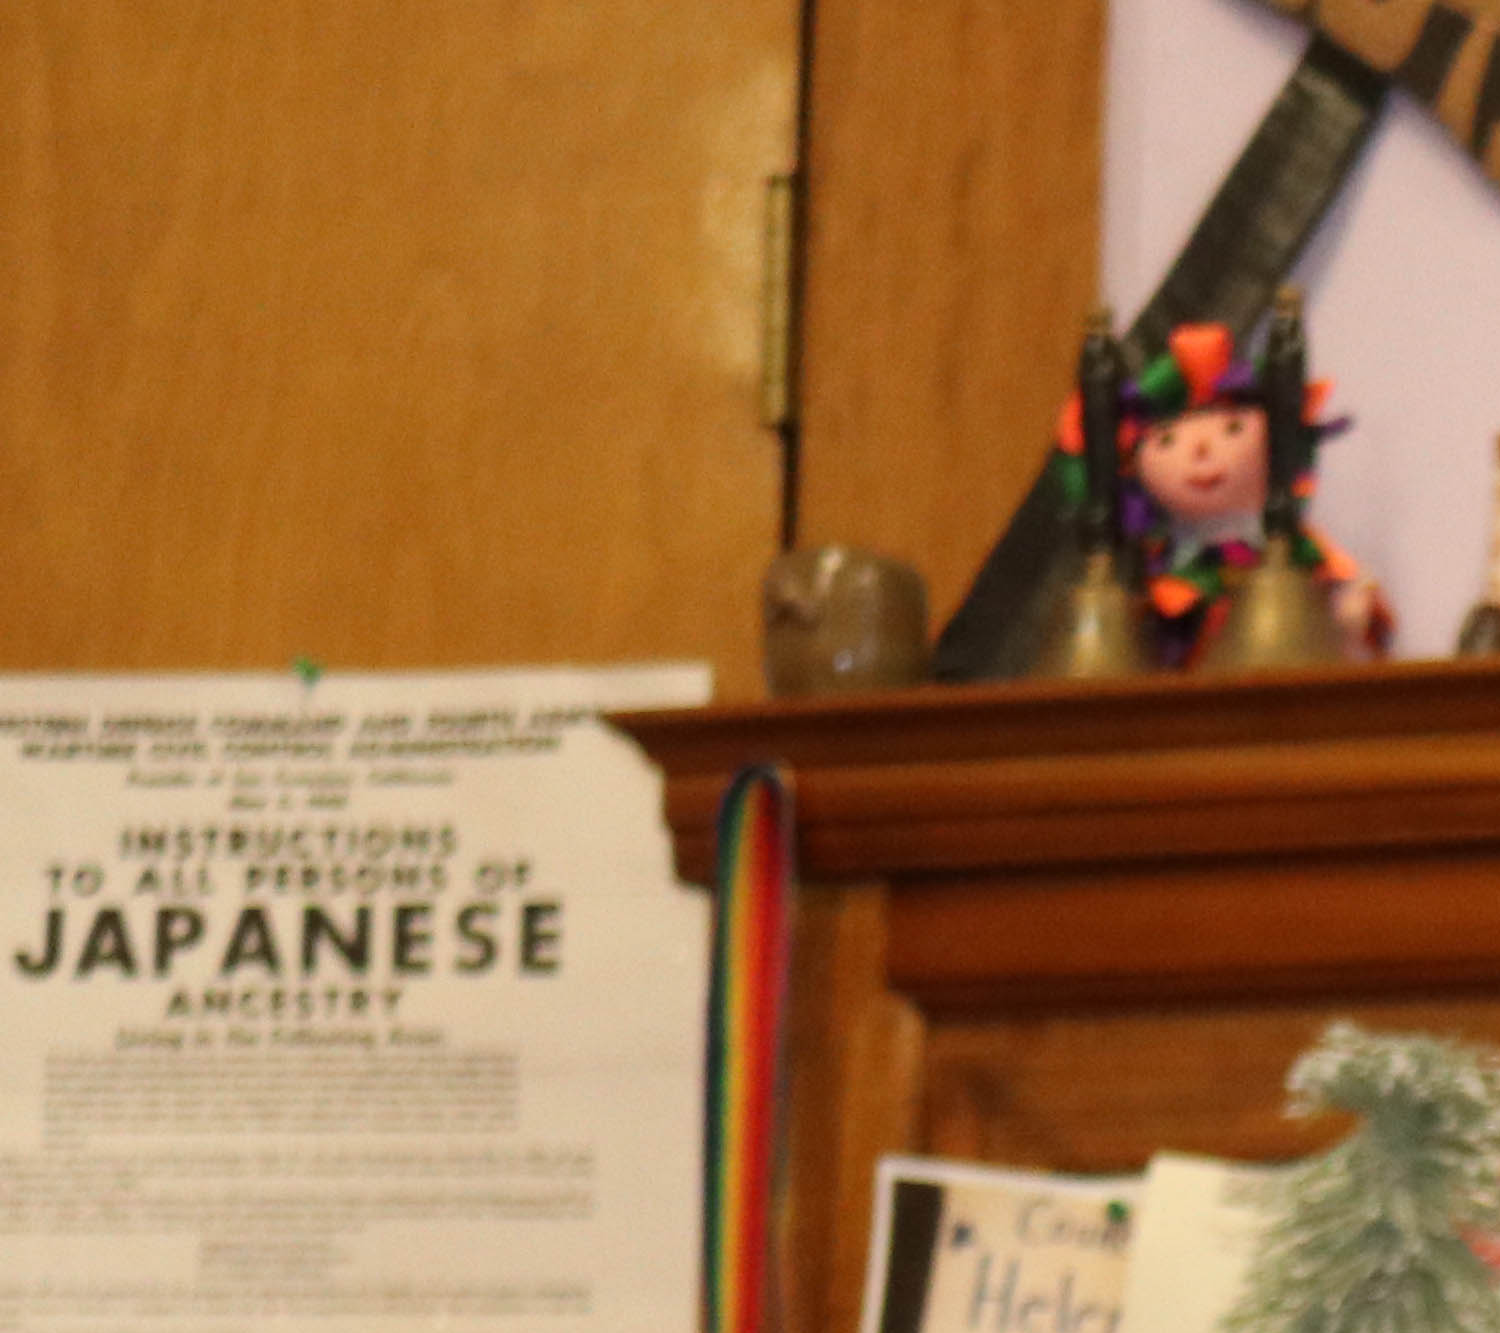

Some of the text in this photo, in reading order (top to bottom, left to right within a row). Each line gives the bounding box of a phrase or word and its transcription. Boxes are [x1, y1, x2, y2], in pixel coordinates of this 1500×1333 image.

[118, 823, 458, 861] INSTRUCTIONS
[44, 857, 532, 898] TO ALL PERSONS OF
[12, 901, 562, 979] JAPANESE
[165, 988, 404, 1020] ANCESTRY
